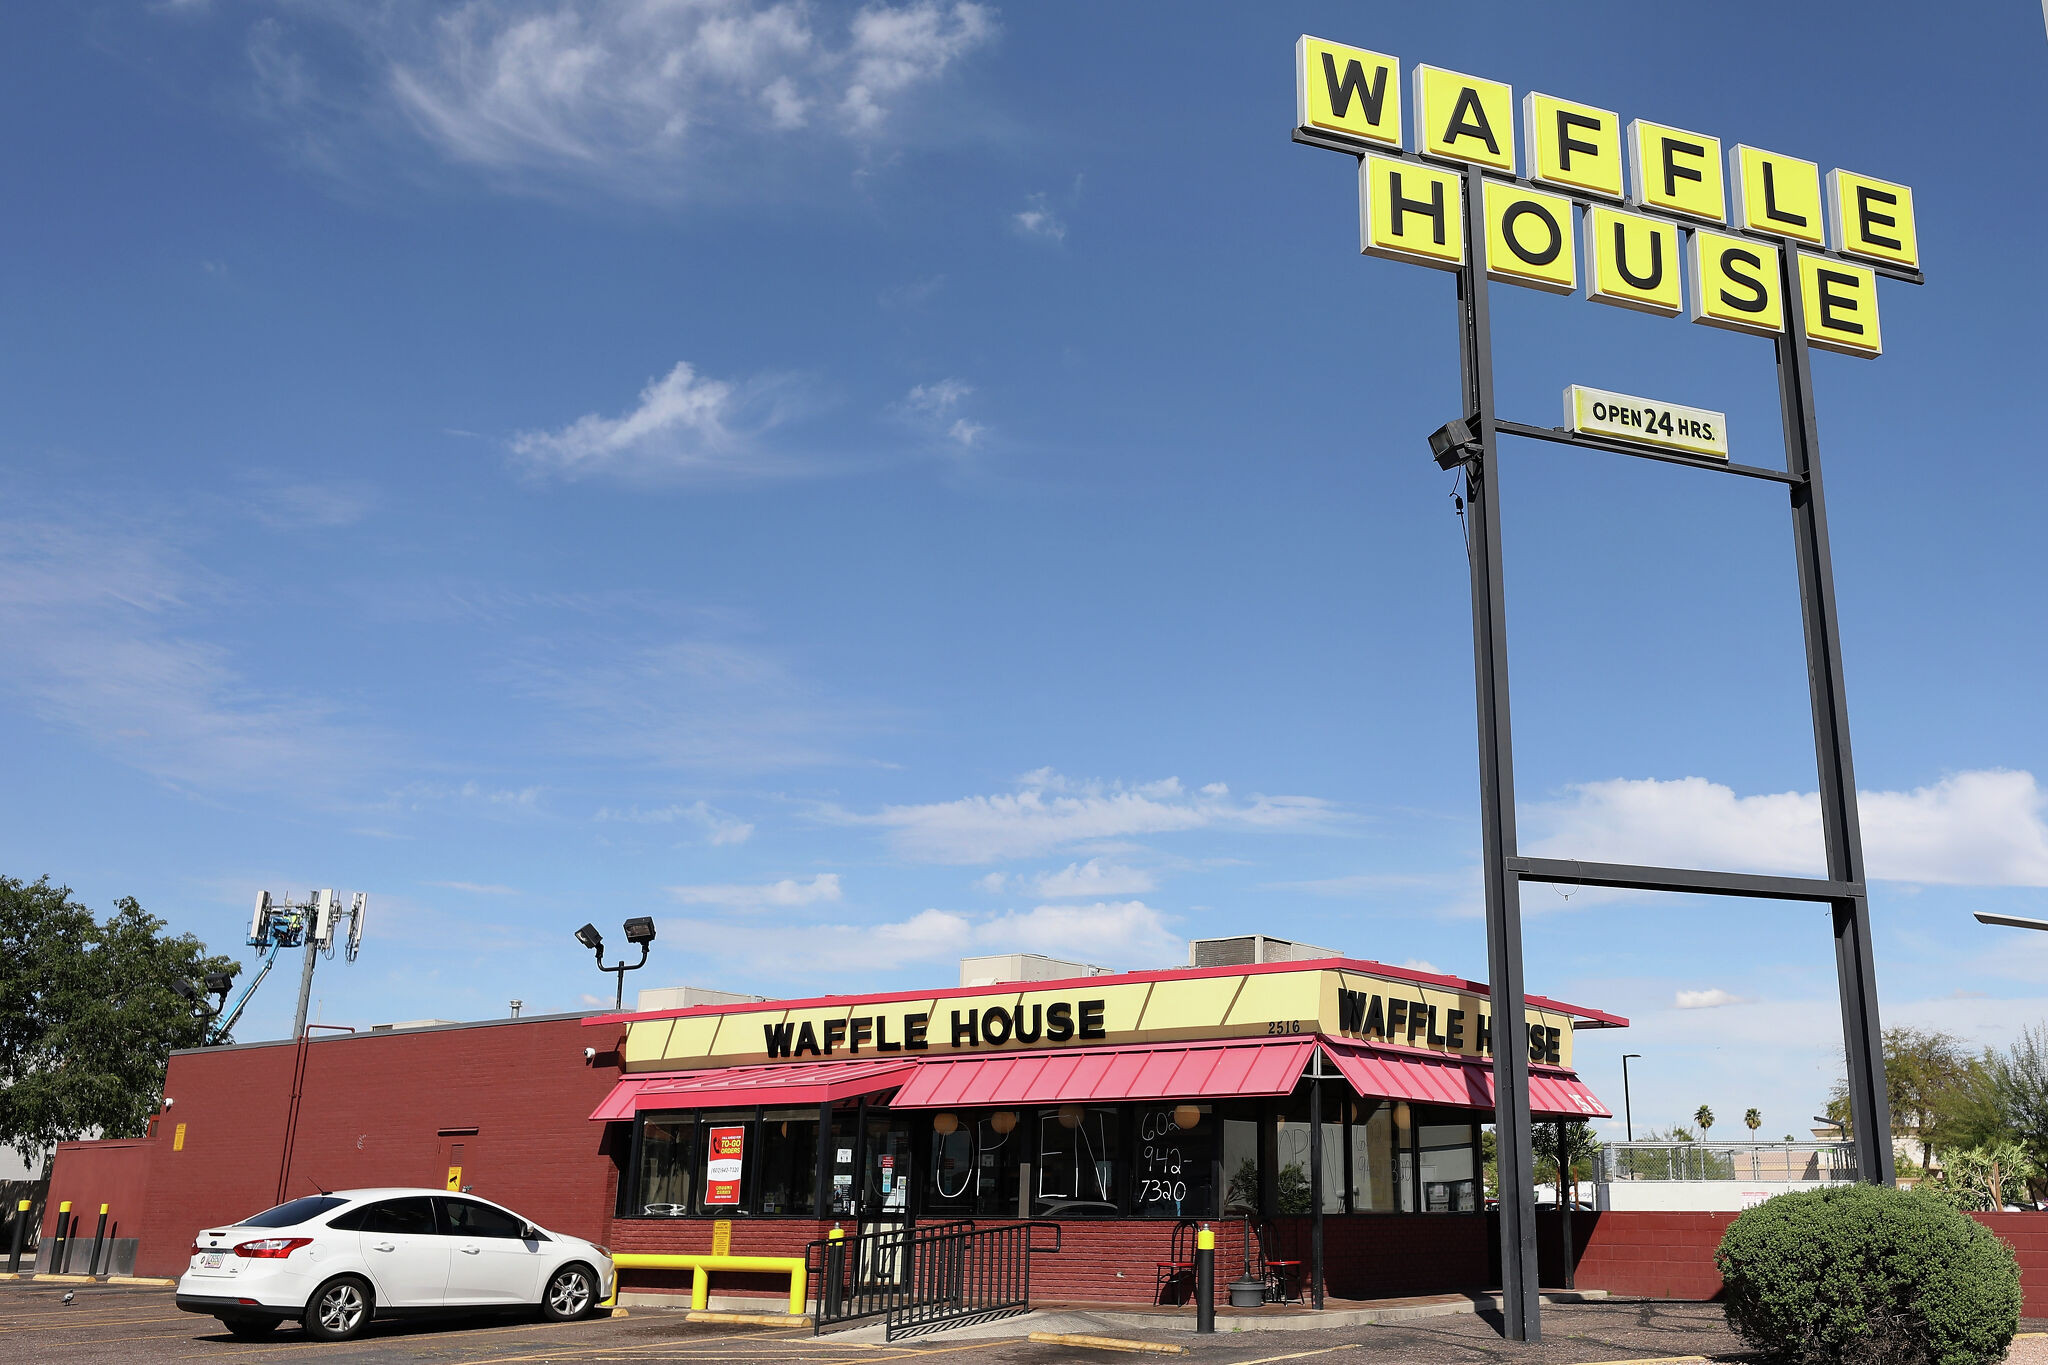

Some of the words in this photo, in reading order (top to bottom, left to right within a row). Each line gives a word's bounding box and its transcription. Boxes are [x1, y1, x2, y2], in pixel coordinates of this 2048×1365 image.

[1321, 52, 1902, 250] WAFFLE
[1390, 171, 1864, 335] HOUSE
[1592, 402, 1642, 428] OPEN
[1644, 408, 1674, 437] 24
[1678, 418, 1716, 440] HRS.
[764, 1013, 928, 1058] WAFFLE
[951, 999, 1106, 1047] HOUSE
[1268, 1020, 1300, 1035] 2516
[1338, 988, 1465, 1048] WAFFLE
[1476, 1014, 1561, 1063] HSE
[721, 1139, 741, 1147] TO-GO
[1139, 1179, 1187, 1202] 7320
